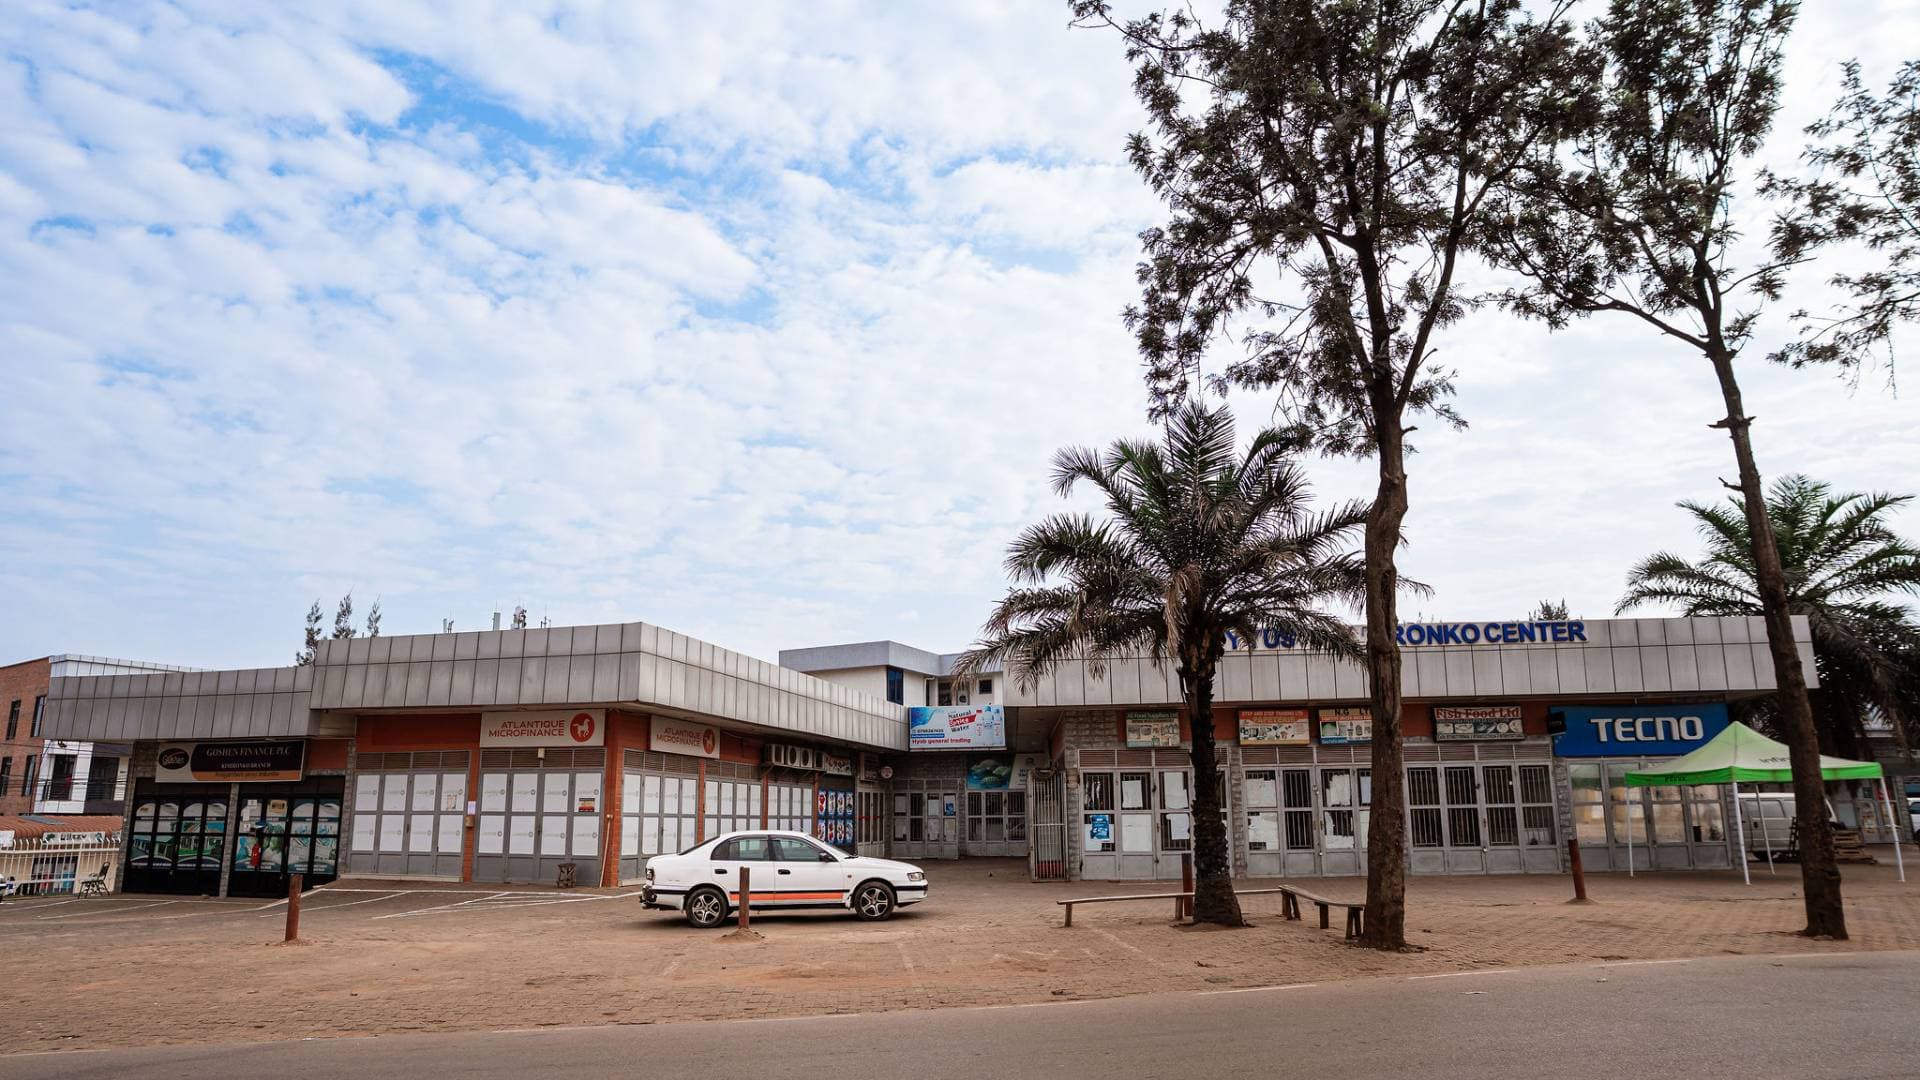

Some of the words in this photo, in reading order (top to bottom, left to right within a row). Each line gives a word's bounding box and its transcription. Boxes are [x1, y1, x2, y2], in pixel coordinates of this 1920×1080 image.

[1396, 623, 1480, 645] RONKO
[1484, 619, 1587, 643] CENTER
[949, 710, 971, 719] Natural
[1435, 708, 1461, 719] Fish
[1465, 707, 1495, 719] Food
[1500, 706, 1520, 718] Ltd
[501, 719, 566, 729] ATLANTIQUE
[951, 724, 970, 733] Water
[1590, 715, 1704, 742] TECNO
[488, 728, 565, 738] MICROFINANCE
[663, 727, 702, 739] ATLANTIQUE
[656, 734, 701, 747] MICROFINANCE
[206, 747, 240, 757] GOSHEN
[239, 746, 274, 756] FINANCE
